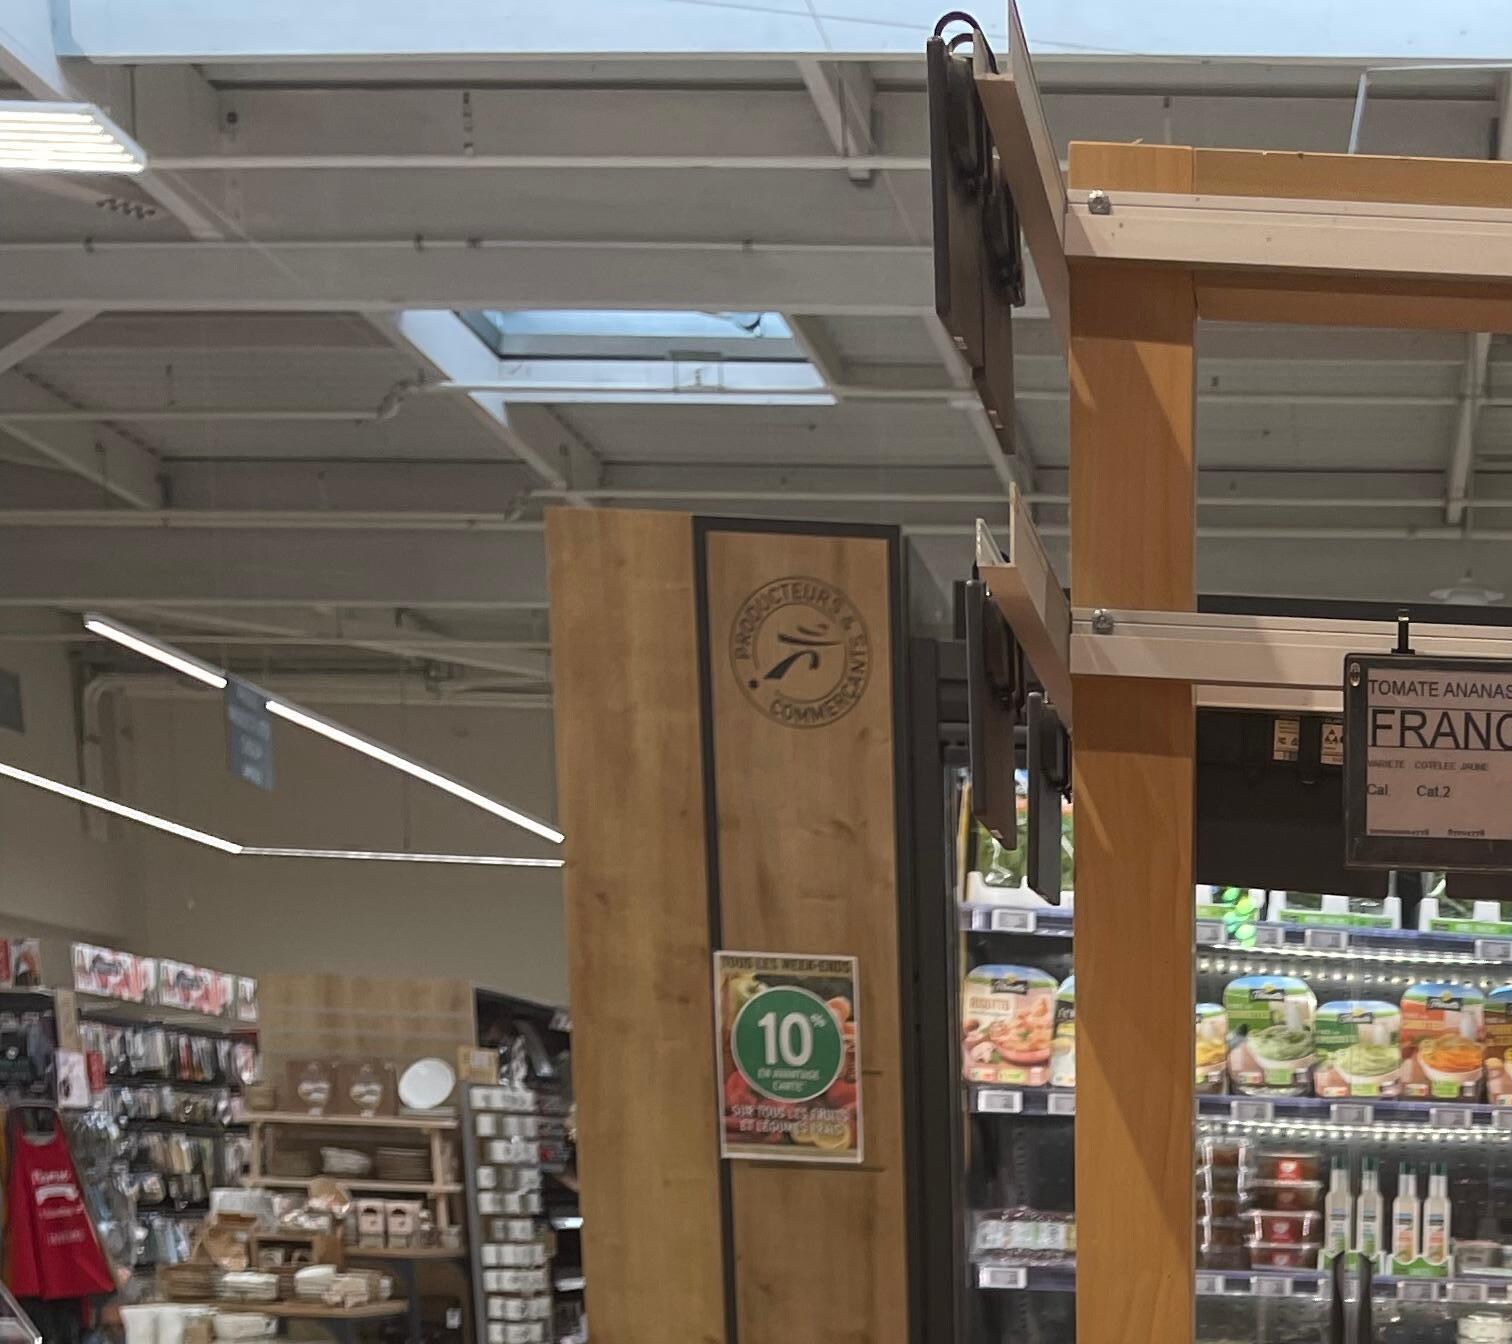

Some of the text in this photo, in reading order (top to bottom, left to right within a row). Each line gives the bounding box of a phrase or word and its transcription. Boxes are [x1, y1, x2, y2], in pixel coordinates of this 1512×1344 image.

[736, 582, 842, 660] PRODUCTEURS
[1369, 679, 1440, 698] TOMATE
[1416, 784, 1451, 799] Cat.2
